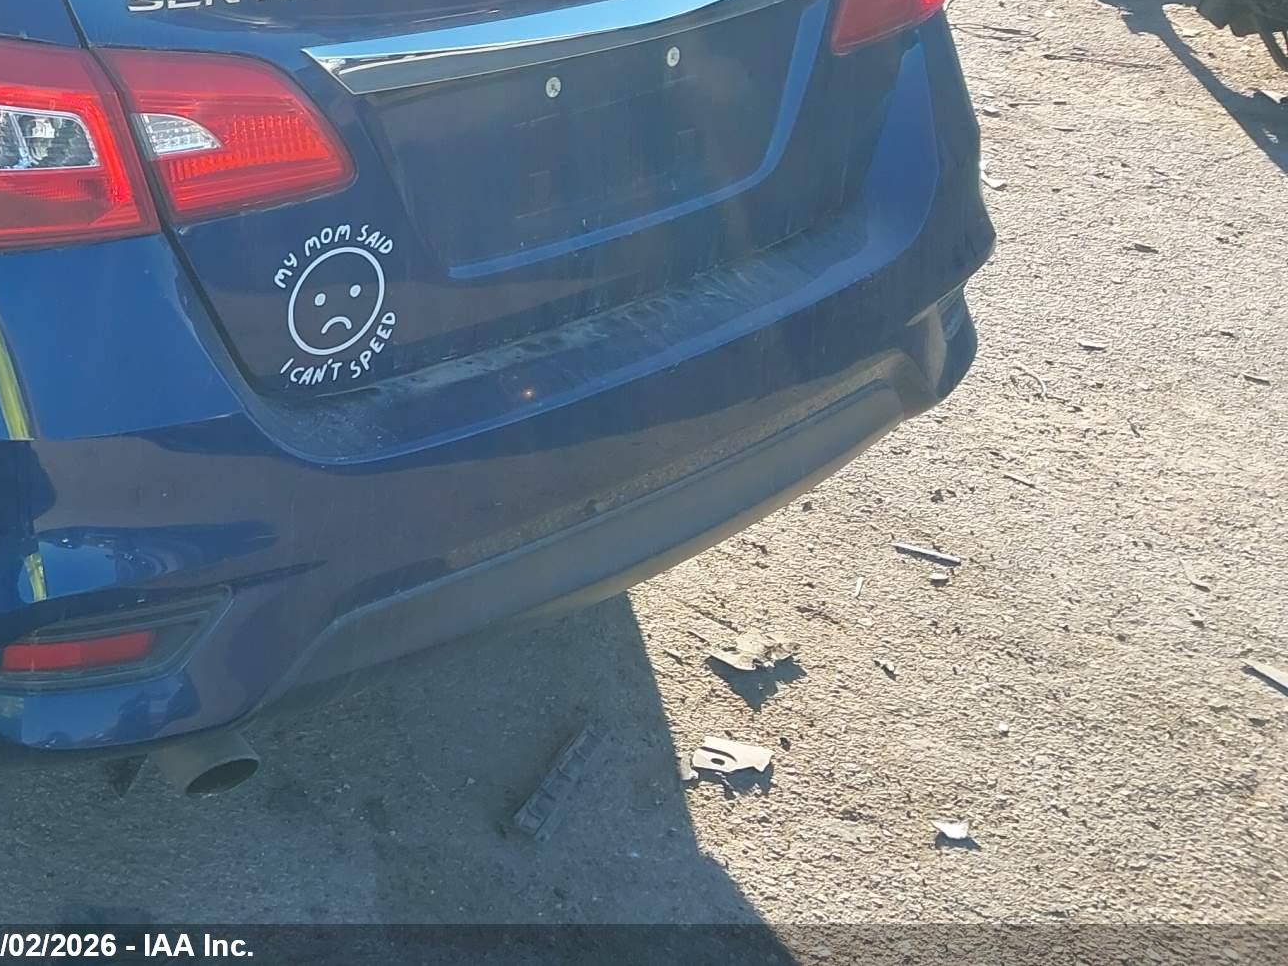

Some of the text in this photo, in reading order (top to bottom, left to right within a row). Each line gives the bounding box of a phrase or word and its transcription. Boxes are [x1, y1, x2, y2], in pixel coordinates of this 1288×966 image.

[274, 224, 394, 289] MY MOM SAID
[289, 358, 343, 386] CAN'T
[350, 311, 397, 379] SPEED
